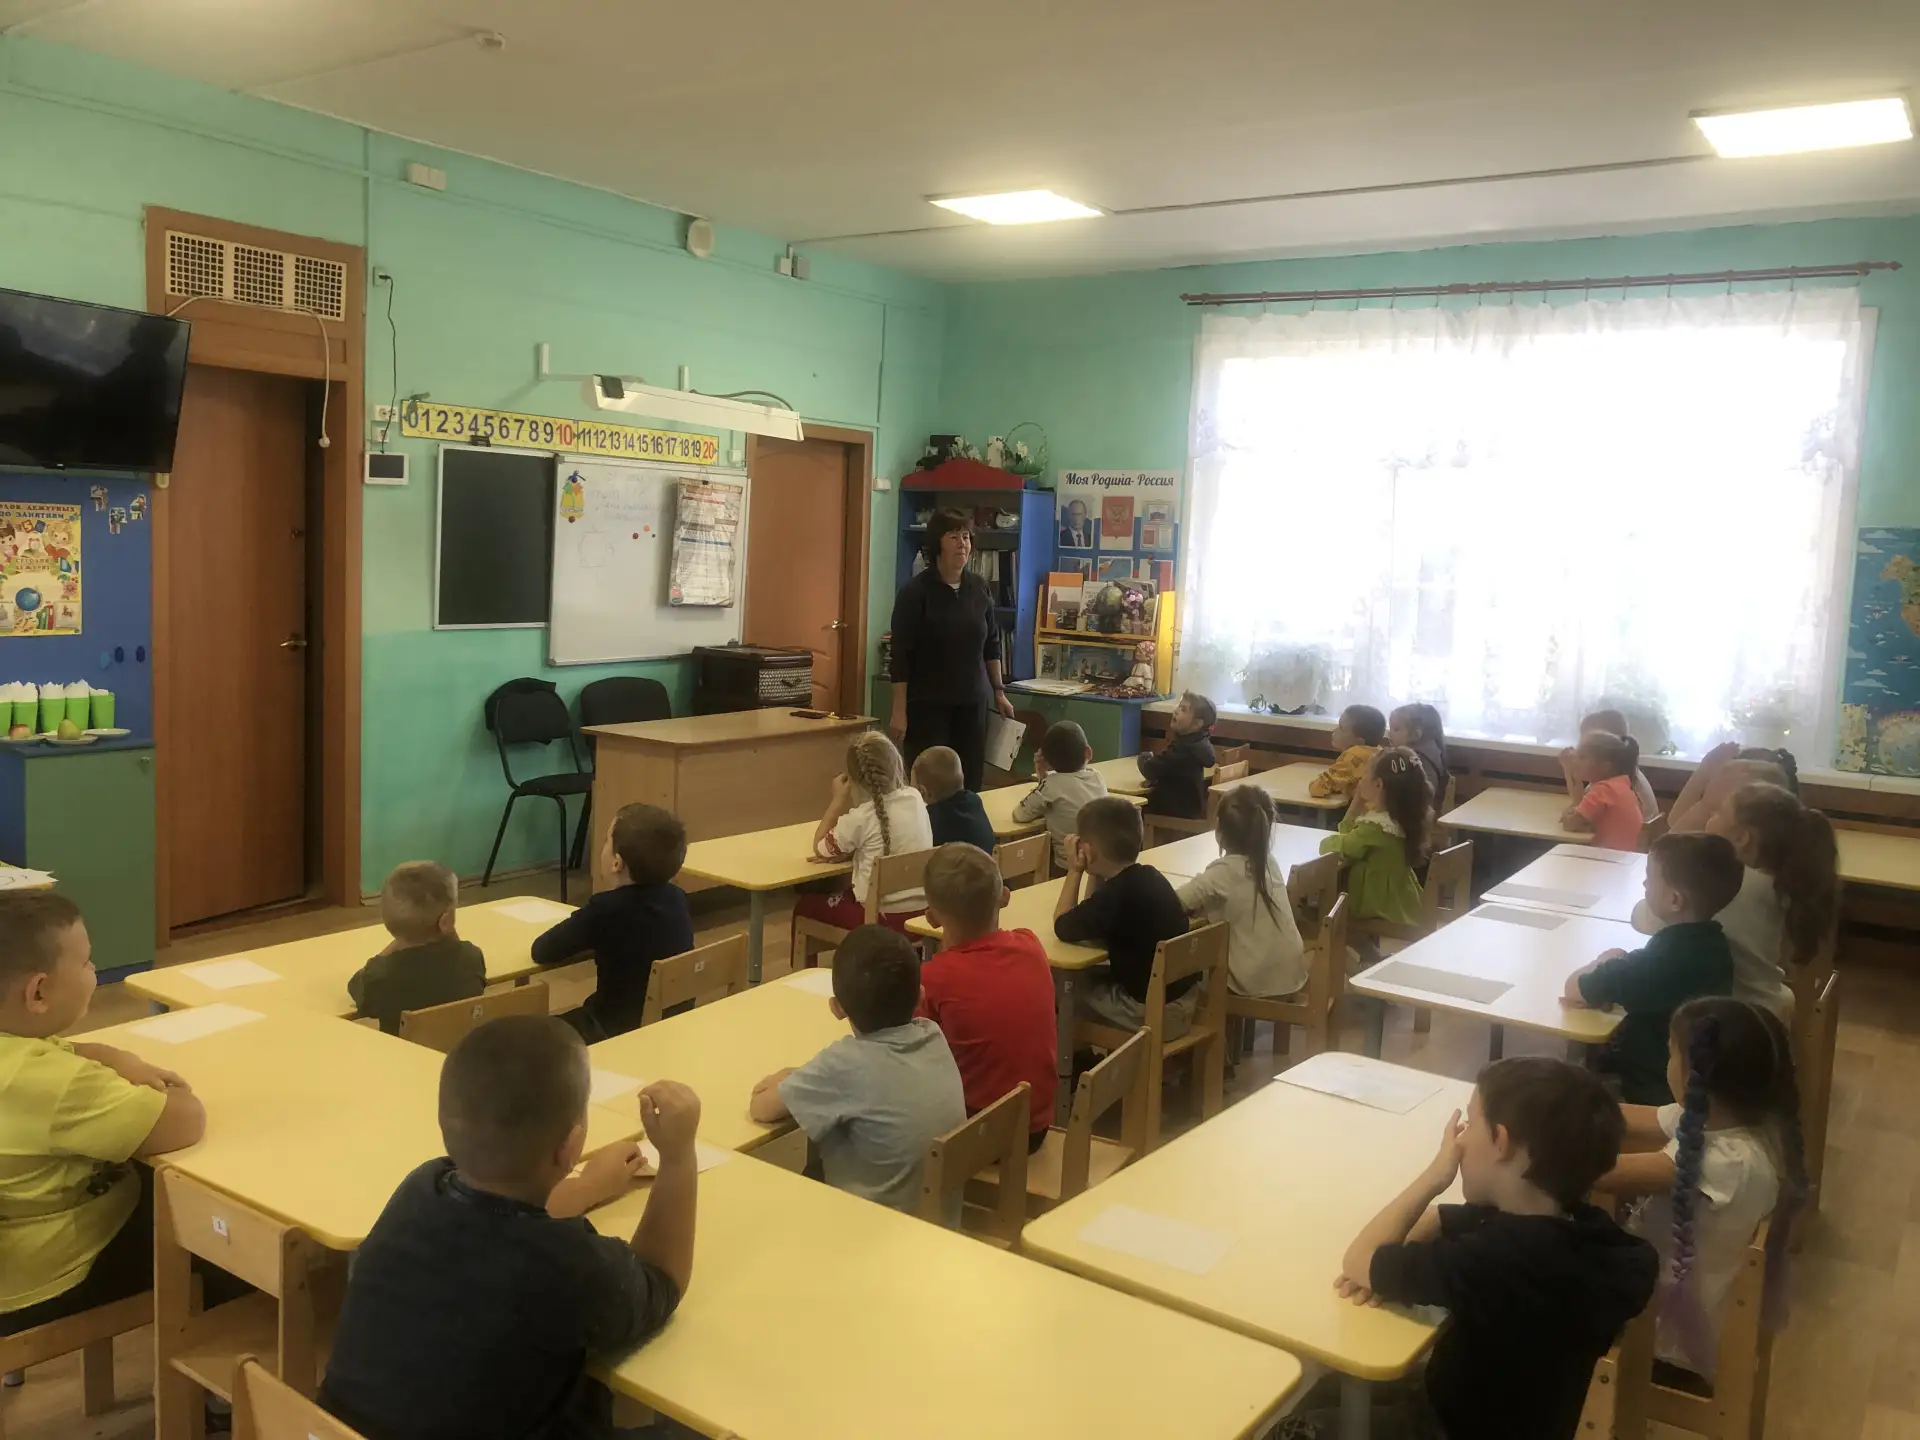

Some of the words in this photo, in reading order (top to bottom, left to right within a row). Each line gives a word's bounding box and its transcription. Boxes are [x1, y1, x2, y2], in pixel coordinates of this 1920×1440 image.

[407, 407, 418, 427] 0
[421, 409, 430, 431] 1
[436, 410, 448, 433] 2
[453, 412, 464, 435] 3
[468, 414, 480, 436] 4
[483, 416, 494, 438] 5
[499, 417, 510, 439] 6
[514, 419, 525, 441] 7
[529, 421, 539, 443] 8
[543, 422, 554, 444] 9
[556, 424, 572, 446] 10
[580, 428, 592, 447] 11
[593, 430, 606, 449] 12
[608, 431, 620, 450] 13
[623, 433, 634, 451] 14
[637, 434, 649, 453] 15
[651, 436, 663, 454] 16
[665, 437, 677, 455] 17
[679, 439, 690, 457] 18
[691, 440, 701, 458] 19
[703, 441, 715, 459] 20
[1065, 472, 1089, 485] Моя
[1137, 474, 1174, 486] Россия
[26, 504, 75, 513] ДЕЖУРНЫХ
